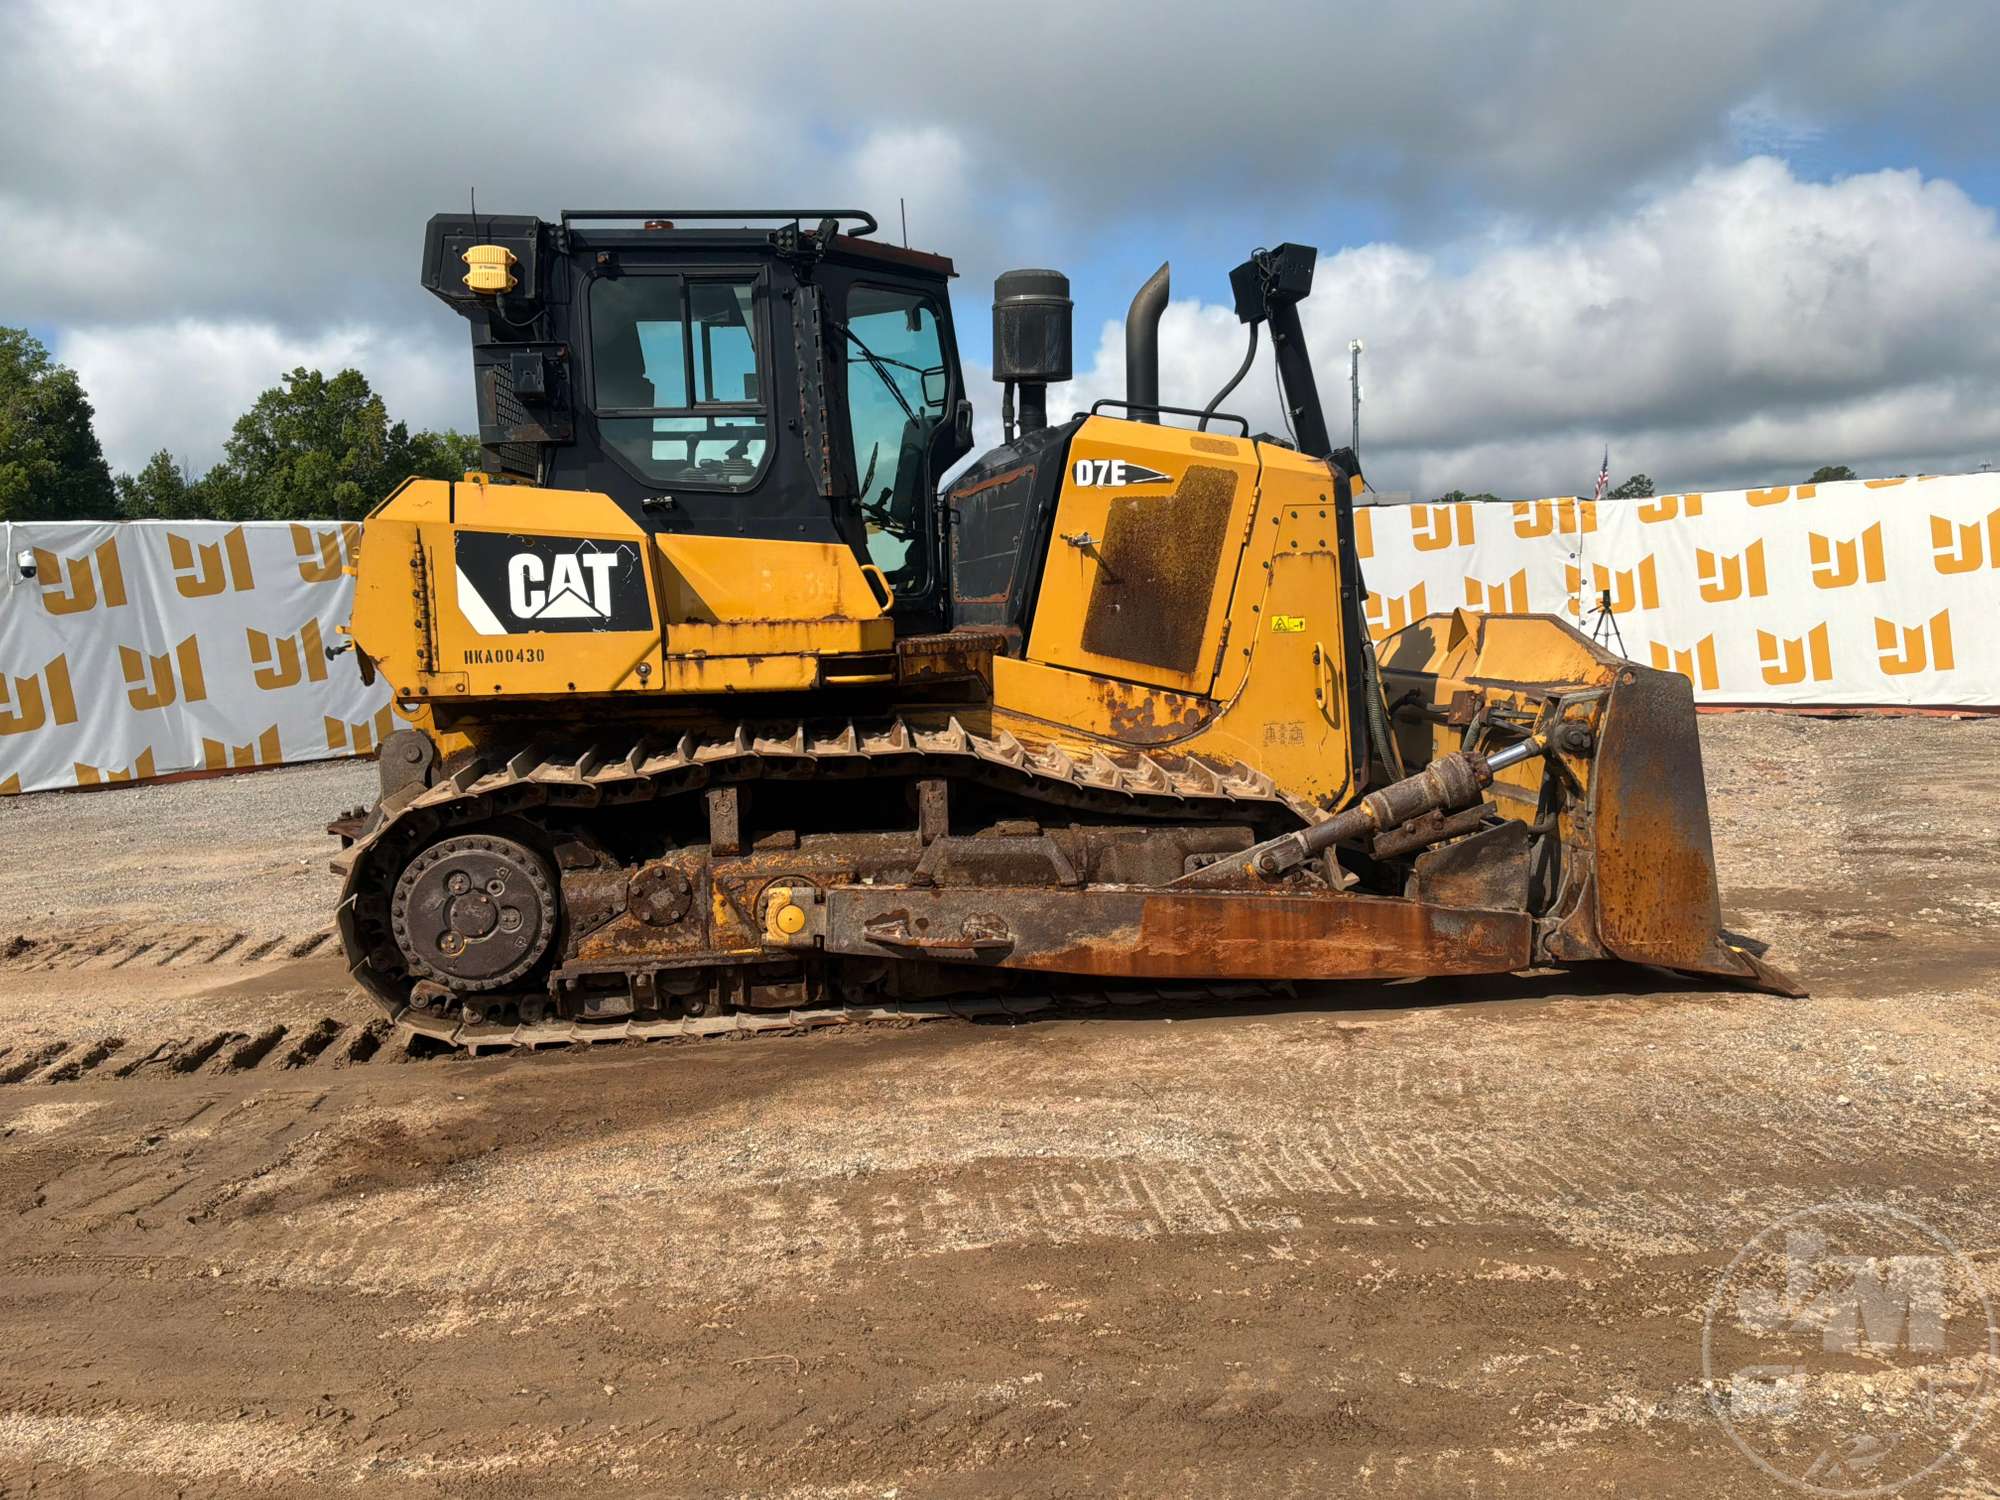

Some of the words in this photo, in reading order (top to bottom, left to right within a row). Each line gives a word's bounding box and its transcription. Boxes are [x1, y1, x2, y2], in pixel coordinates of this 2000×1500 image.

[1076, 459, 1126, 487] D7E
[508, 552, 619, 619] CAT
[463, 648, 546, 665] HKA00430
